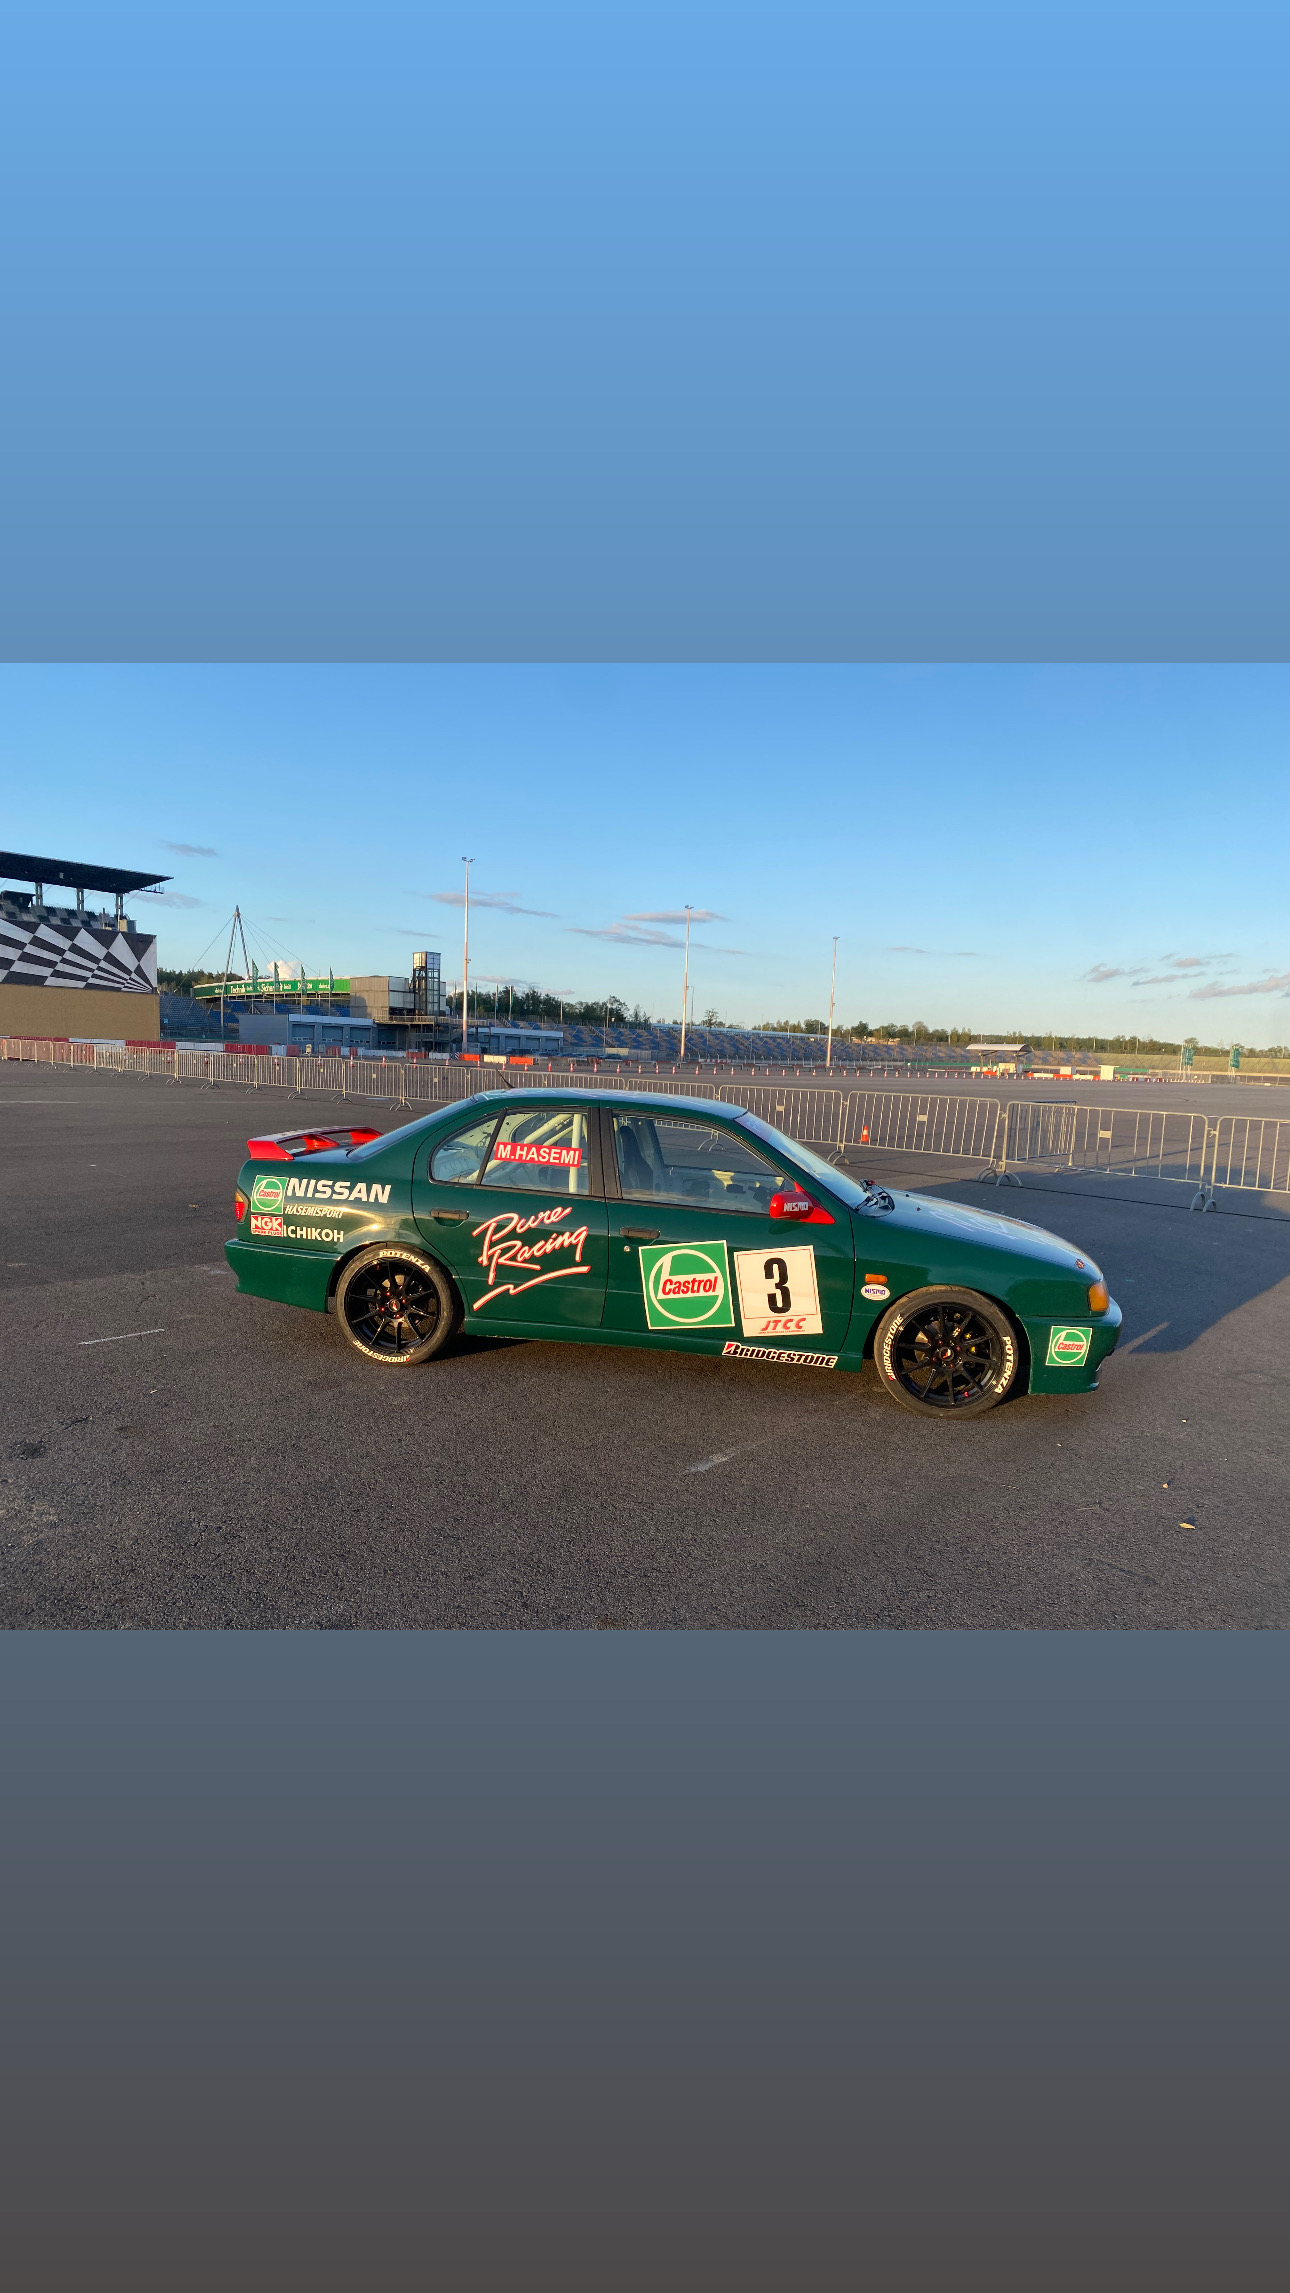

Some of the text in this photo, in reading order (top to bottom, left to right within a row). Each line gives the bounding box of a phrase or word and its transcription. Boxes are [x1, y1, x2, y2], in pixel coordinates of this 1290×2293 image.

[497, 1144, 580, 1165] M.HASEMI
[258, 1189, 282, 1199] Castrol
[286, 1177, 392, 1203] NISSAN
[251, 1216, 282, 1231] NGK
[283, 1225, 345, 1242] ICHIKOH
[472, 1207, 572, 1266] Pure
[379, 1249, 431, 1273] POTENZA
[479, 1226, 588, 1285] Racing
[661, 1275, 718, 1296] Castrol
[763, 1257, 792, 1314] 3
[353, 1339, 411, 1363] BRIDGESTONE
[723, 1341, 838, 1368] BRIDGESTONE
[884, 1313, 904, 1381] BRIDGESTONE
[1057, 1340, 1084, 1351] Castrol
[994, 1336, 1014, 1394] POTENZA
